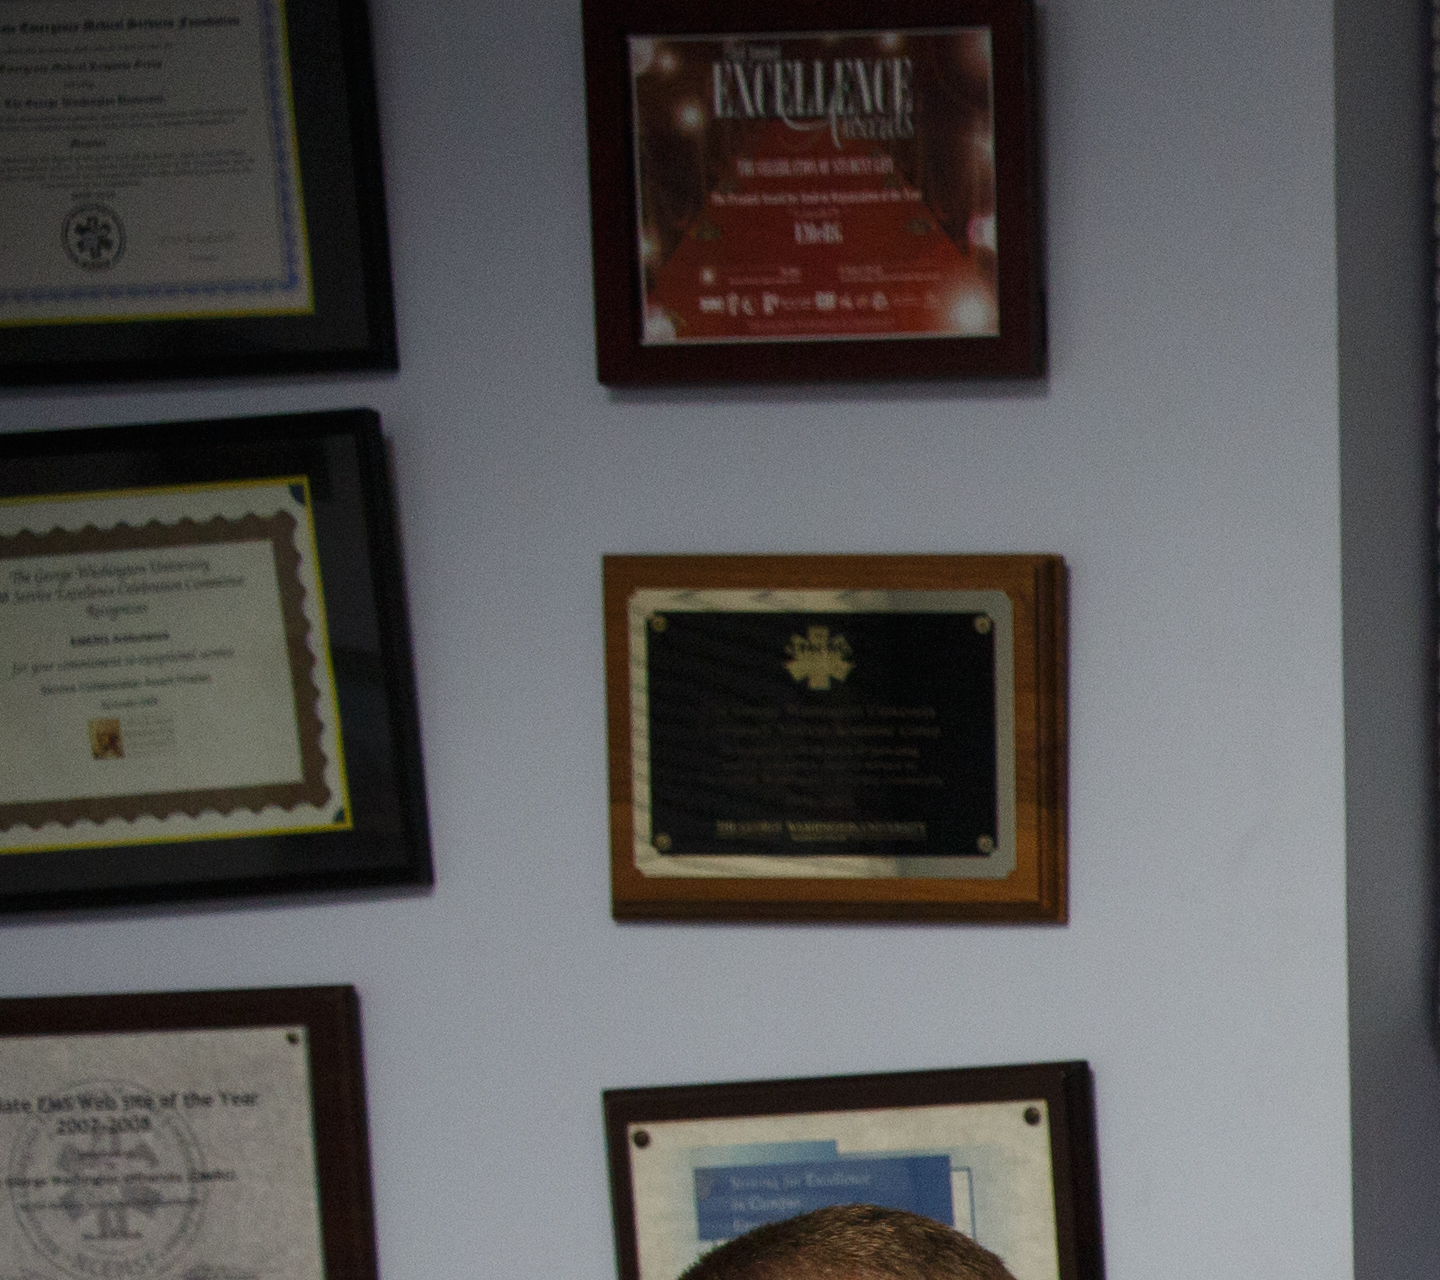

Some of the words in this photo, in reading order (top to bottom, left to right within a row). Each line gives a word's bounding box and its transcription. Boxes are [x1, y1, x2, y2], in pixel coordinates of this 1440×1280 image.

[712, 56, 915, 119] EXCELLENCE
[182, 1091, 214, 1109] the
[219, 1089, 260, 1108] Year
